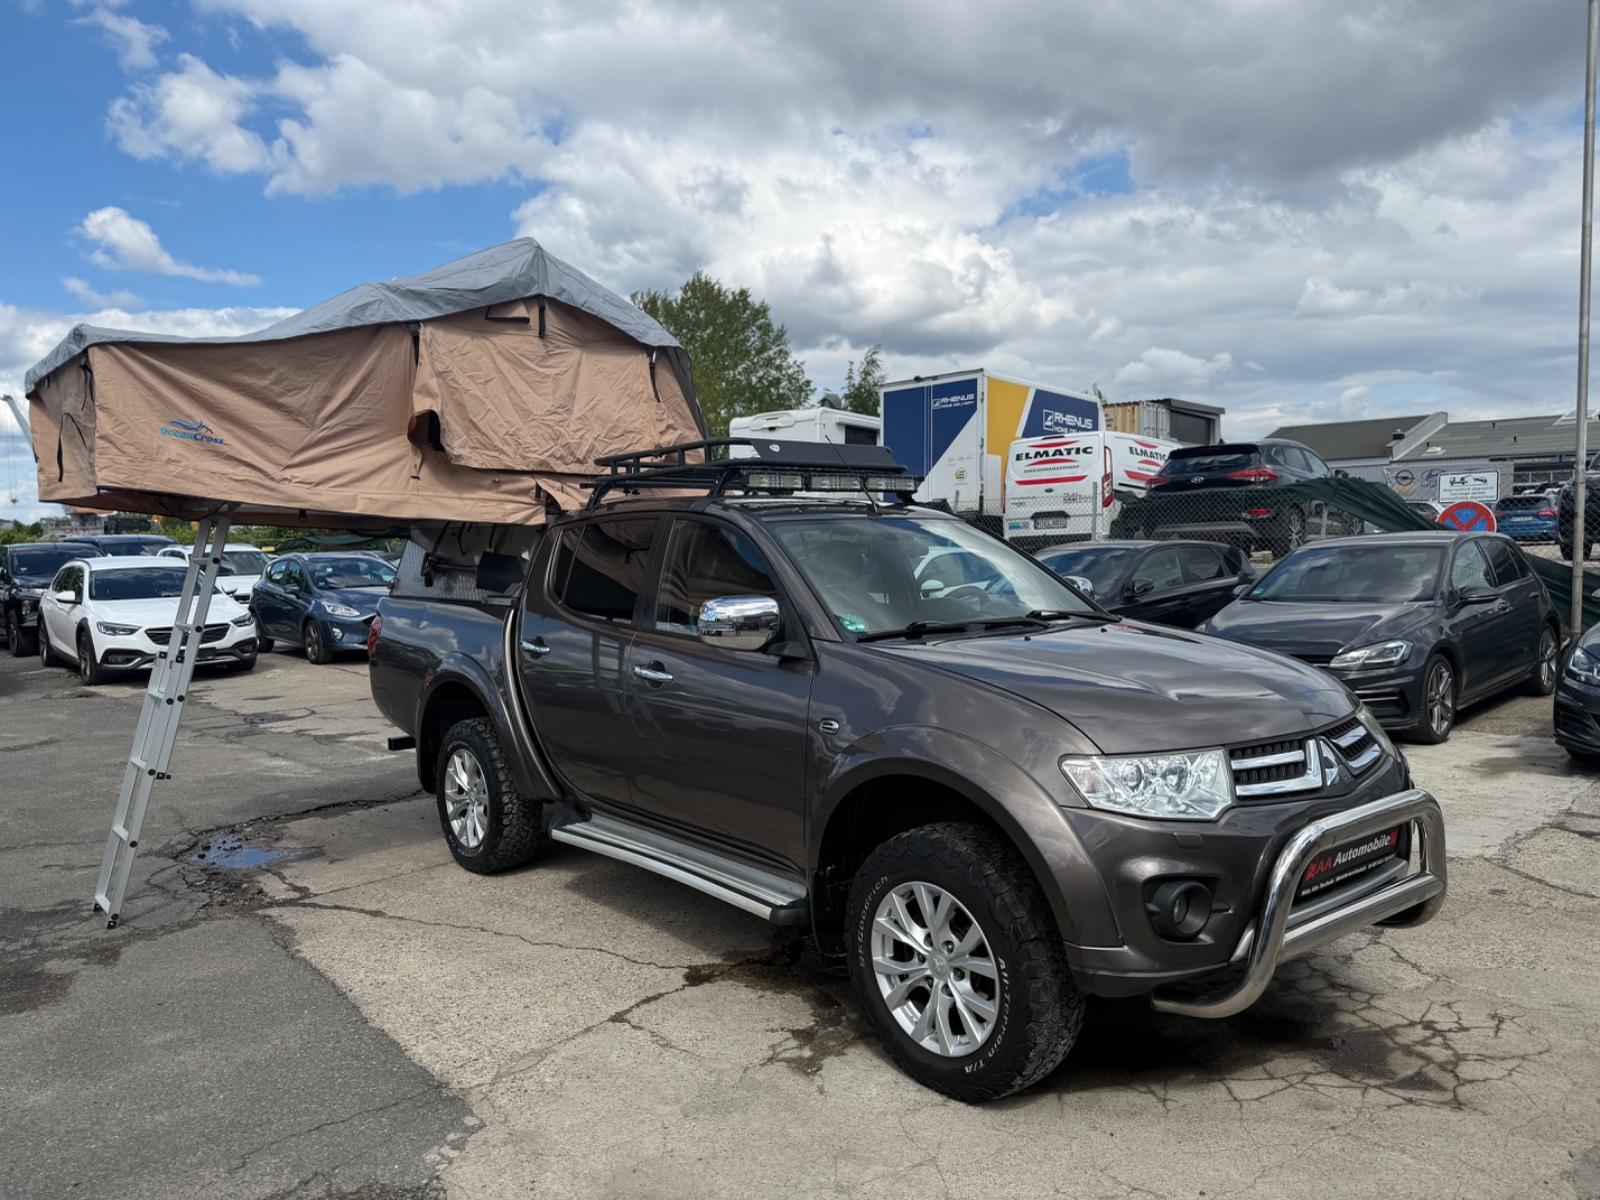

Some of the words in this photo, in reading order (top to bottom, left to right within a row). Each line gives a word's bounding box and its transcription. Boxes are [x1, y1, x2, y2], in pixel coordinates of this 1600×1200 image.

[941, 393, 975, 403] RHENUS
[1054, 411, 1093, 429] RHENUS
[1015, 446, 1093, 461] ELMATIC
[1128, 446, 1167, 461] ELMATIC
[1333, 833, 1391, 867] Automobile
